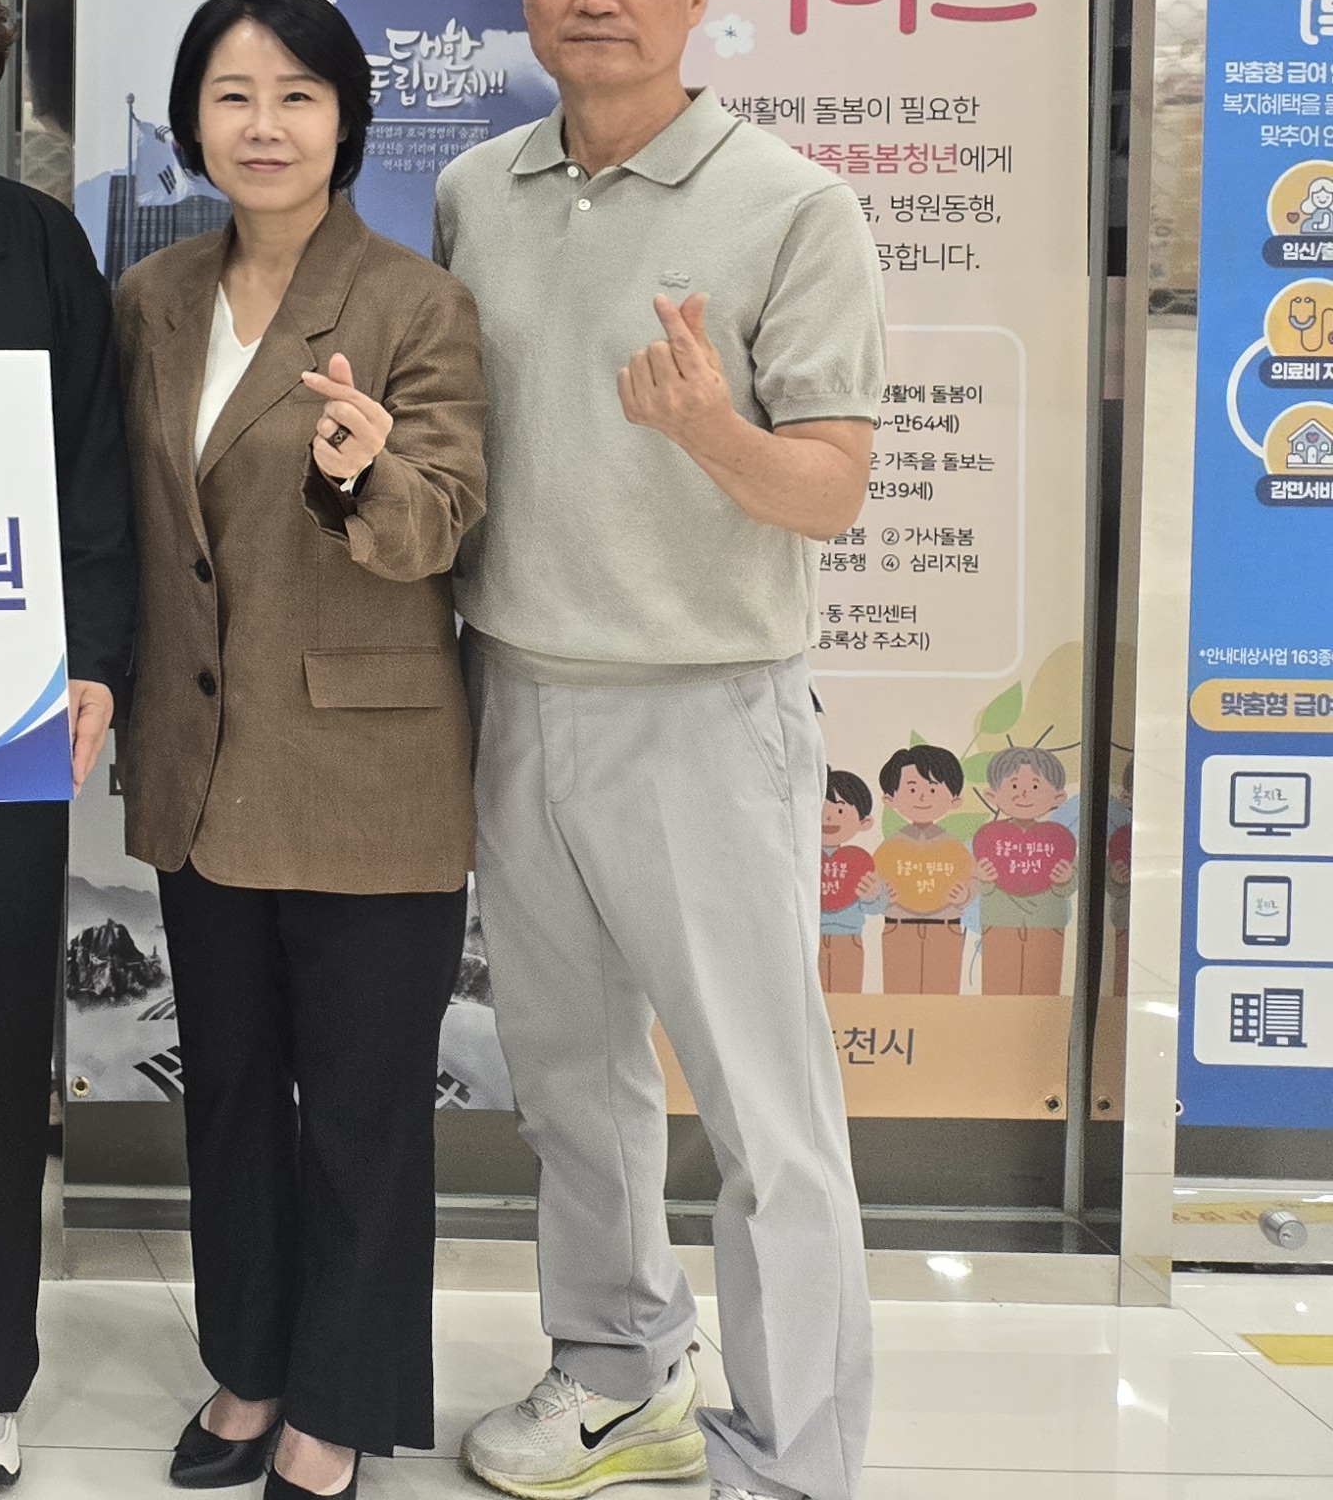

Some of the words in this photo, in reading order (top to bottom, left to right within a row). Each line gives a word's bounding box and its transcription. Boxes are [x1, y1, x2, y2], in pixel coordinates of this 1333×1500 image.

[386, 18, 482, 71] 대한
[1224, 60, 1284, 84] 맞춤형
[1287, 60, 1327, 84] 급여
[812, 95, 892, 126] 돌봄이
[899, 95, 981, 126] 필요한
[1222, 92, 1321, 116] 복지혜택을
[1260, 124, 1320, 148] 맞추어
[890, 193, 1002, 225] 병원동행,
[1270, 362, 1320, 381] 의료비
[930, 384, 984, 404] 돌봄이
[885, 452, 938, 472] 가족을
[942, 452, 996, 472] 돌보는
[904, 526, 975, 547] 가사돌봄
[910, 553, 980, 573] 심리지원
[847, 604, 918, 624] 주민센터
[872, 630, 931, 651] 주소지)
[1220, 691, 1289, 718] 맞춤형
[832, 1026, 915, 1066] 천시
